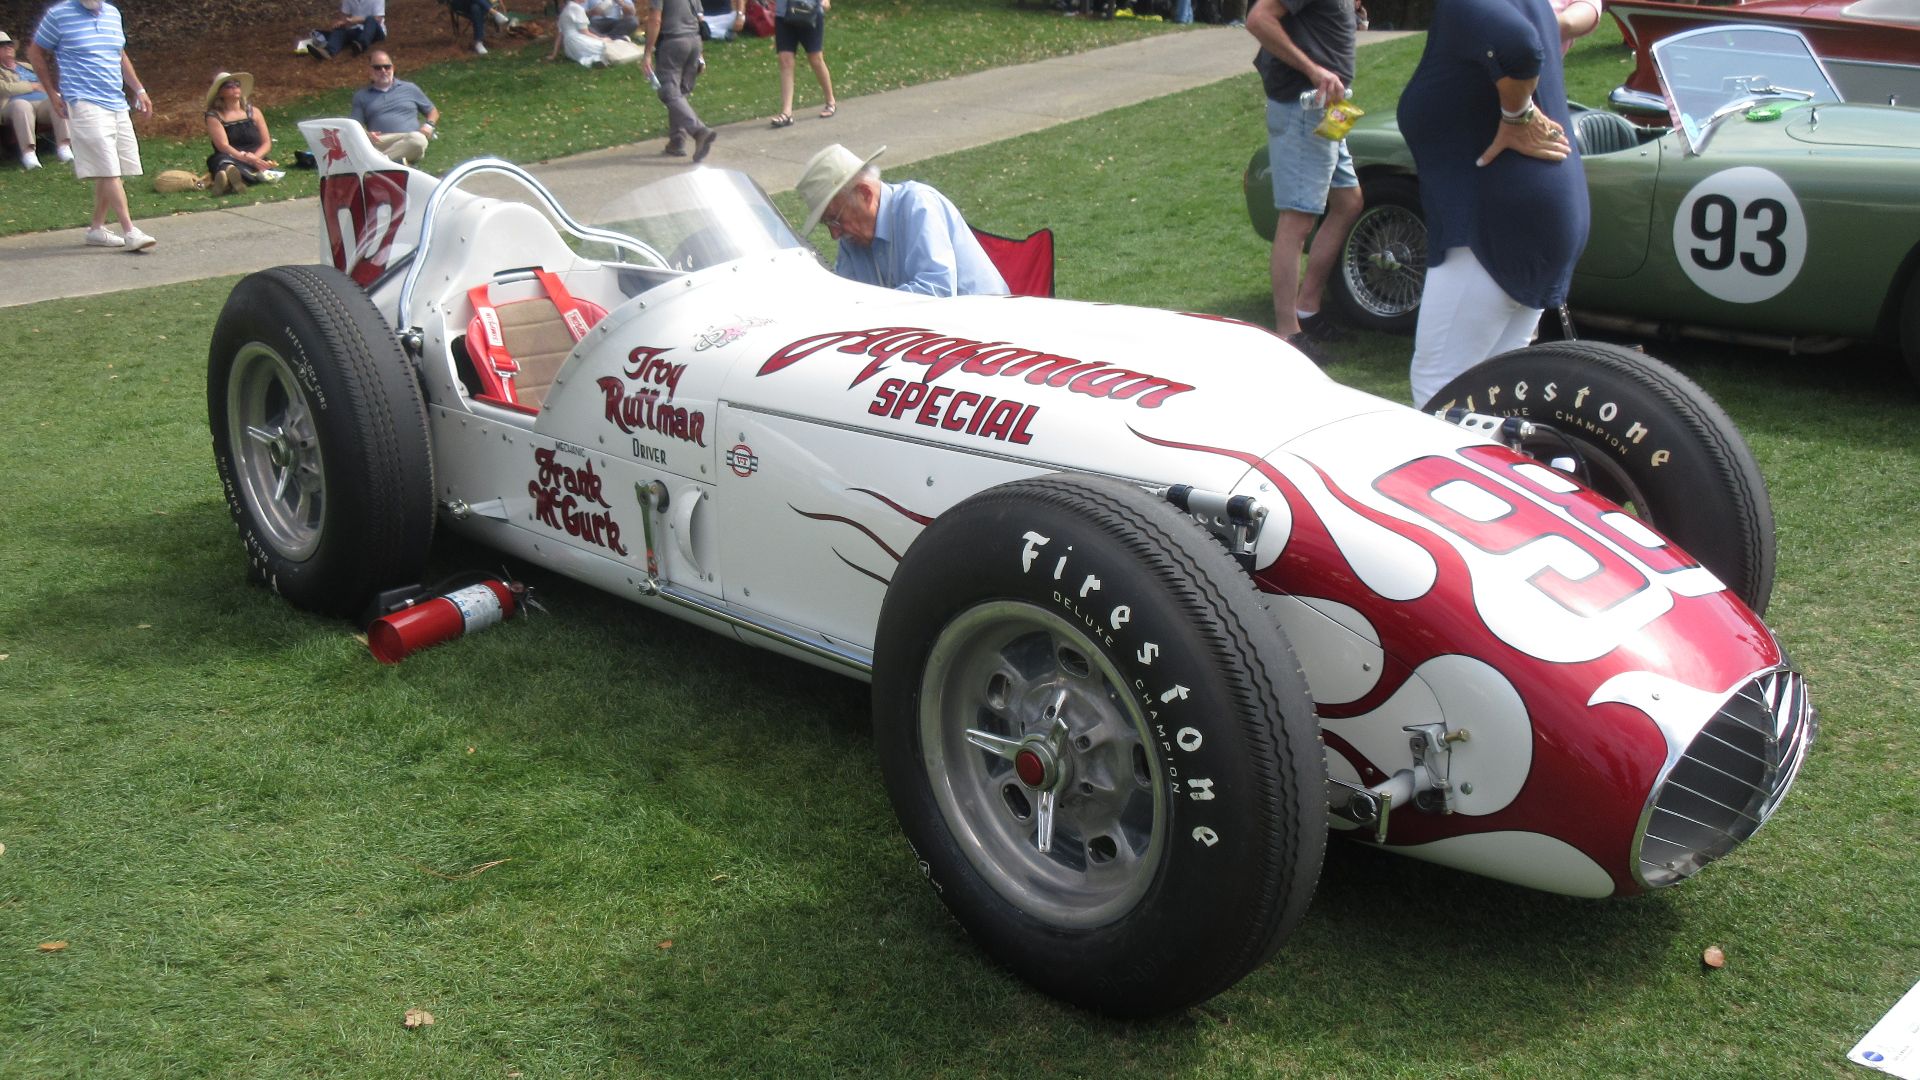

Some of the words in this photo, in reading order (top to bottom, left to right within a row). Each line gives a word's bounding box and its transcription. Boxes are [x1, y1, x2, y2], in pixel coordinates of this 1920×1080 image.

[1690, 193, 1788, 277] 93
[623, 346, 688, 403] Troy
[596, 376, 707, 448] Ruttman
[868, 377, 1040, 445] SPECIAL
[1555, 410, 1628, 455] CHAMPION
[535, 447, 613, 509] Frank
[1022, 530, 1219, 847] Firestone
[1053, 590, 1114, 648] DELUXE
[1134, 678, 1181, 794] CHAMPION
